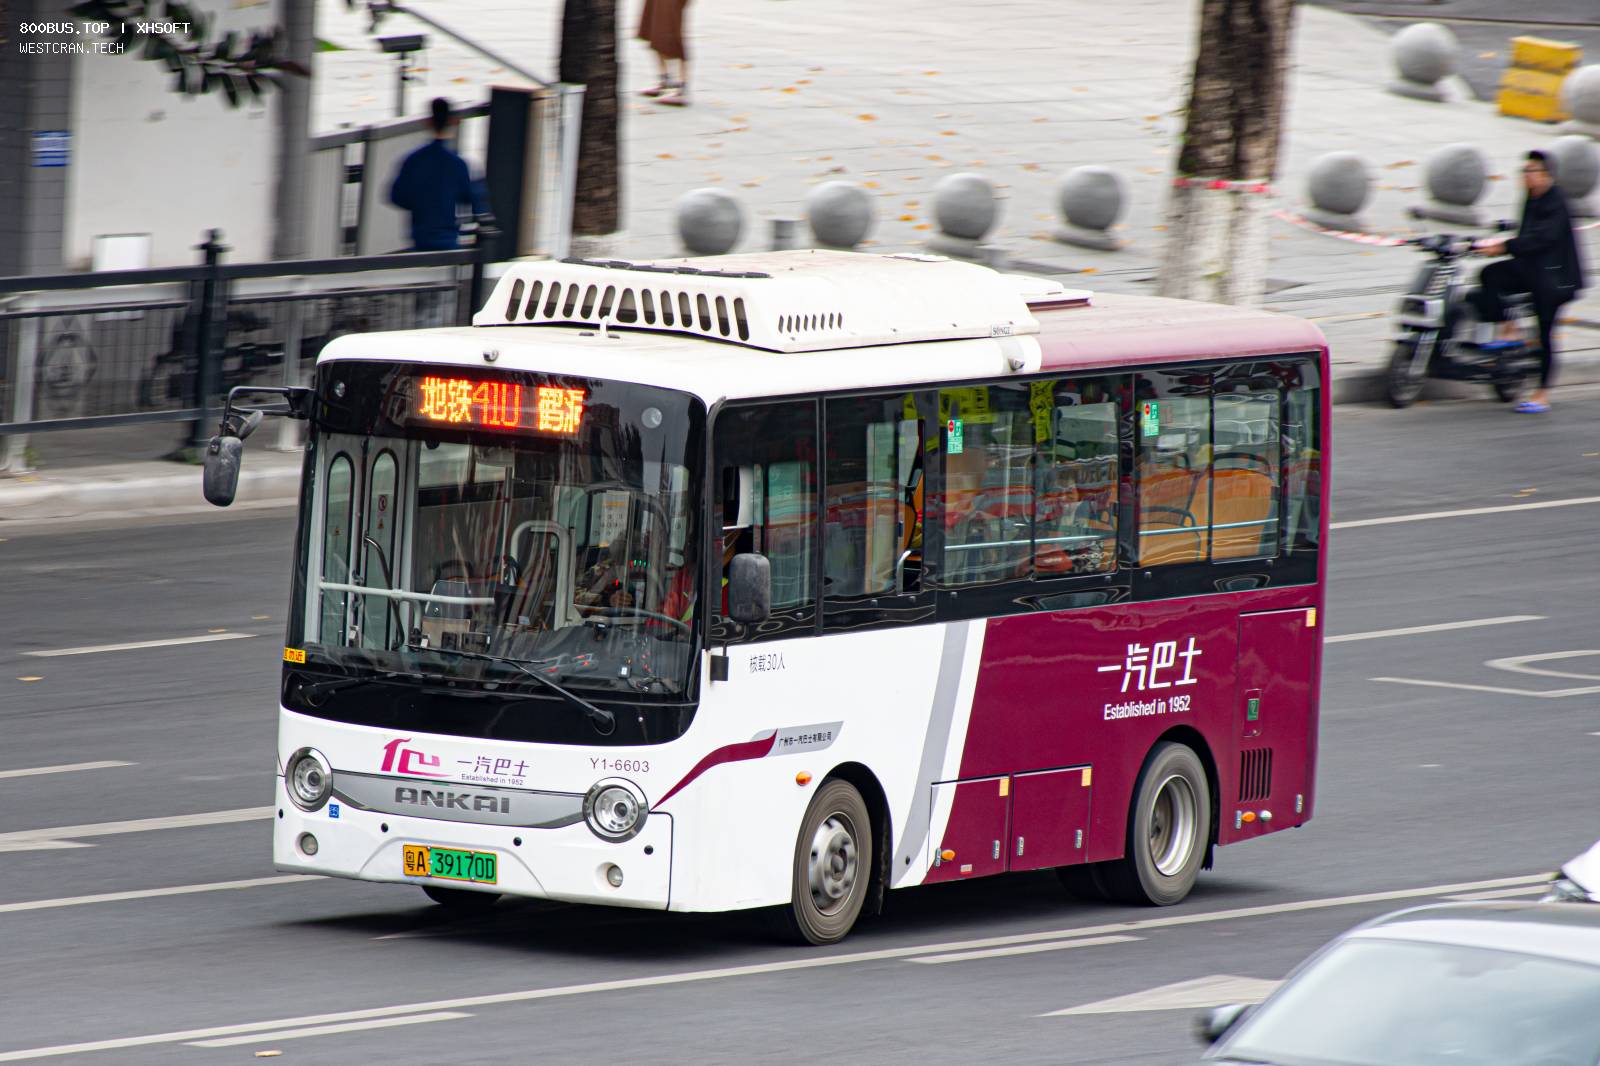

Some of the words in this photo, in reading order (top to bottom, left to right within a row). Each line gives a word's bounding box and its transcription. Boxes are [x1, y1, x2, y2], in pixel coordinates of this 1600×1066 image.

[749, 650, 786, 673] 核载30人
[1097, 637, 1202, 693] 一汽巴士
[1103, 698, 1157, 720] Established
[1157, 698, 1166, 714] in
[1168, 694, 1191, 713] 1952
[457, 755, 530, 777] 一汽巴士
[589, 757, 650, 773] Y1-6603
[461, 773, 499, 784] Established
[508, 778, 524, 786] 1952
[394, 786, 511, 815] ANKAI
